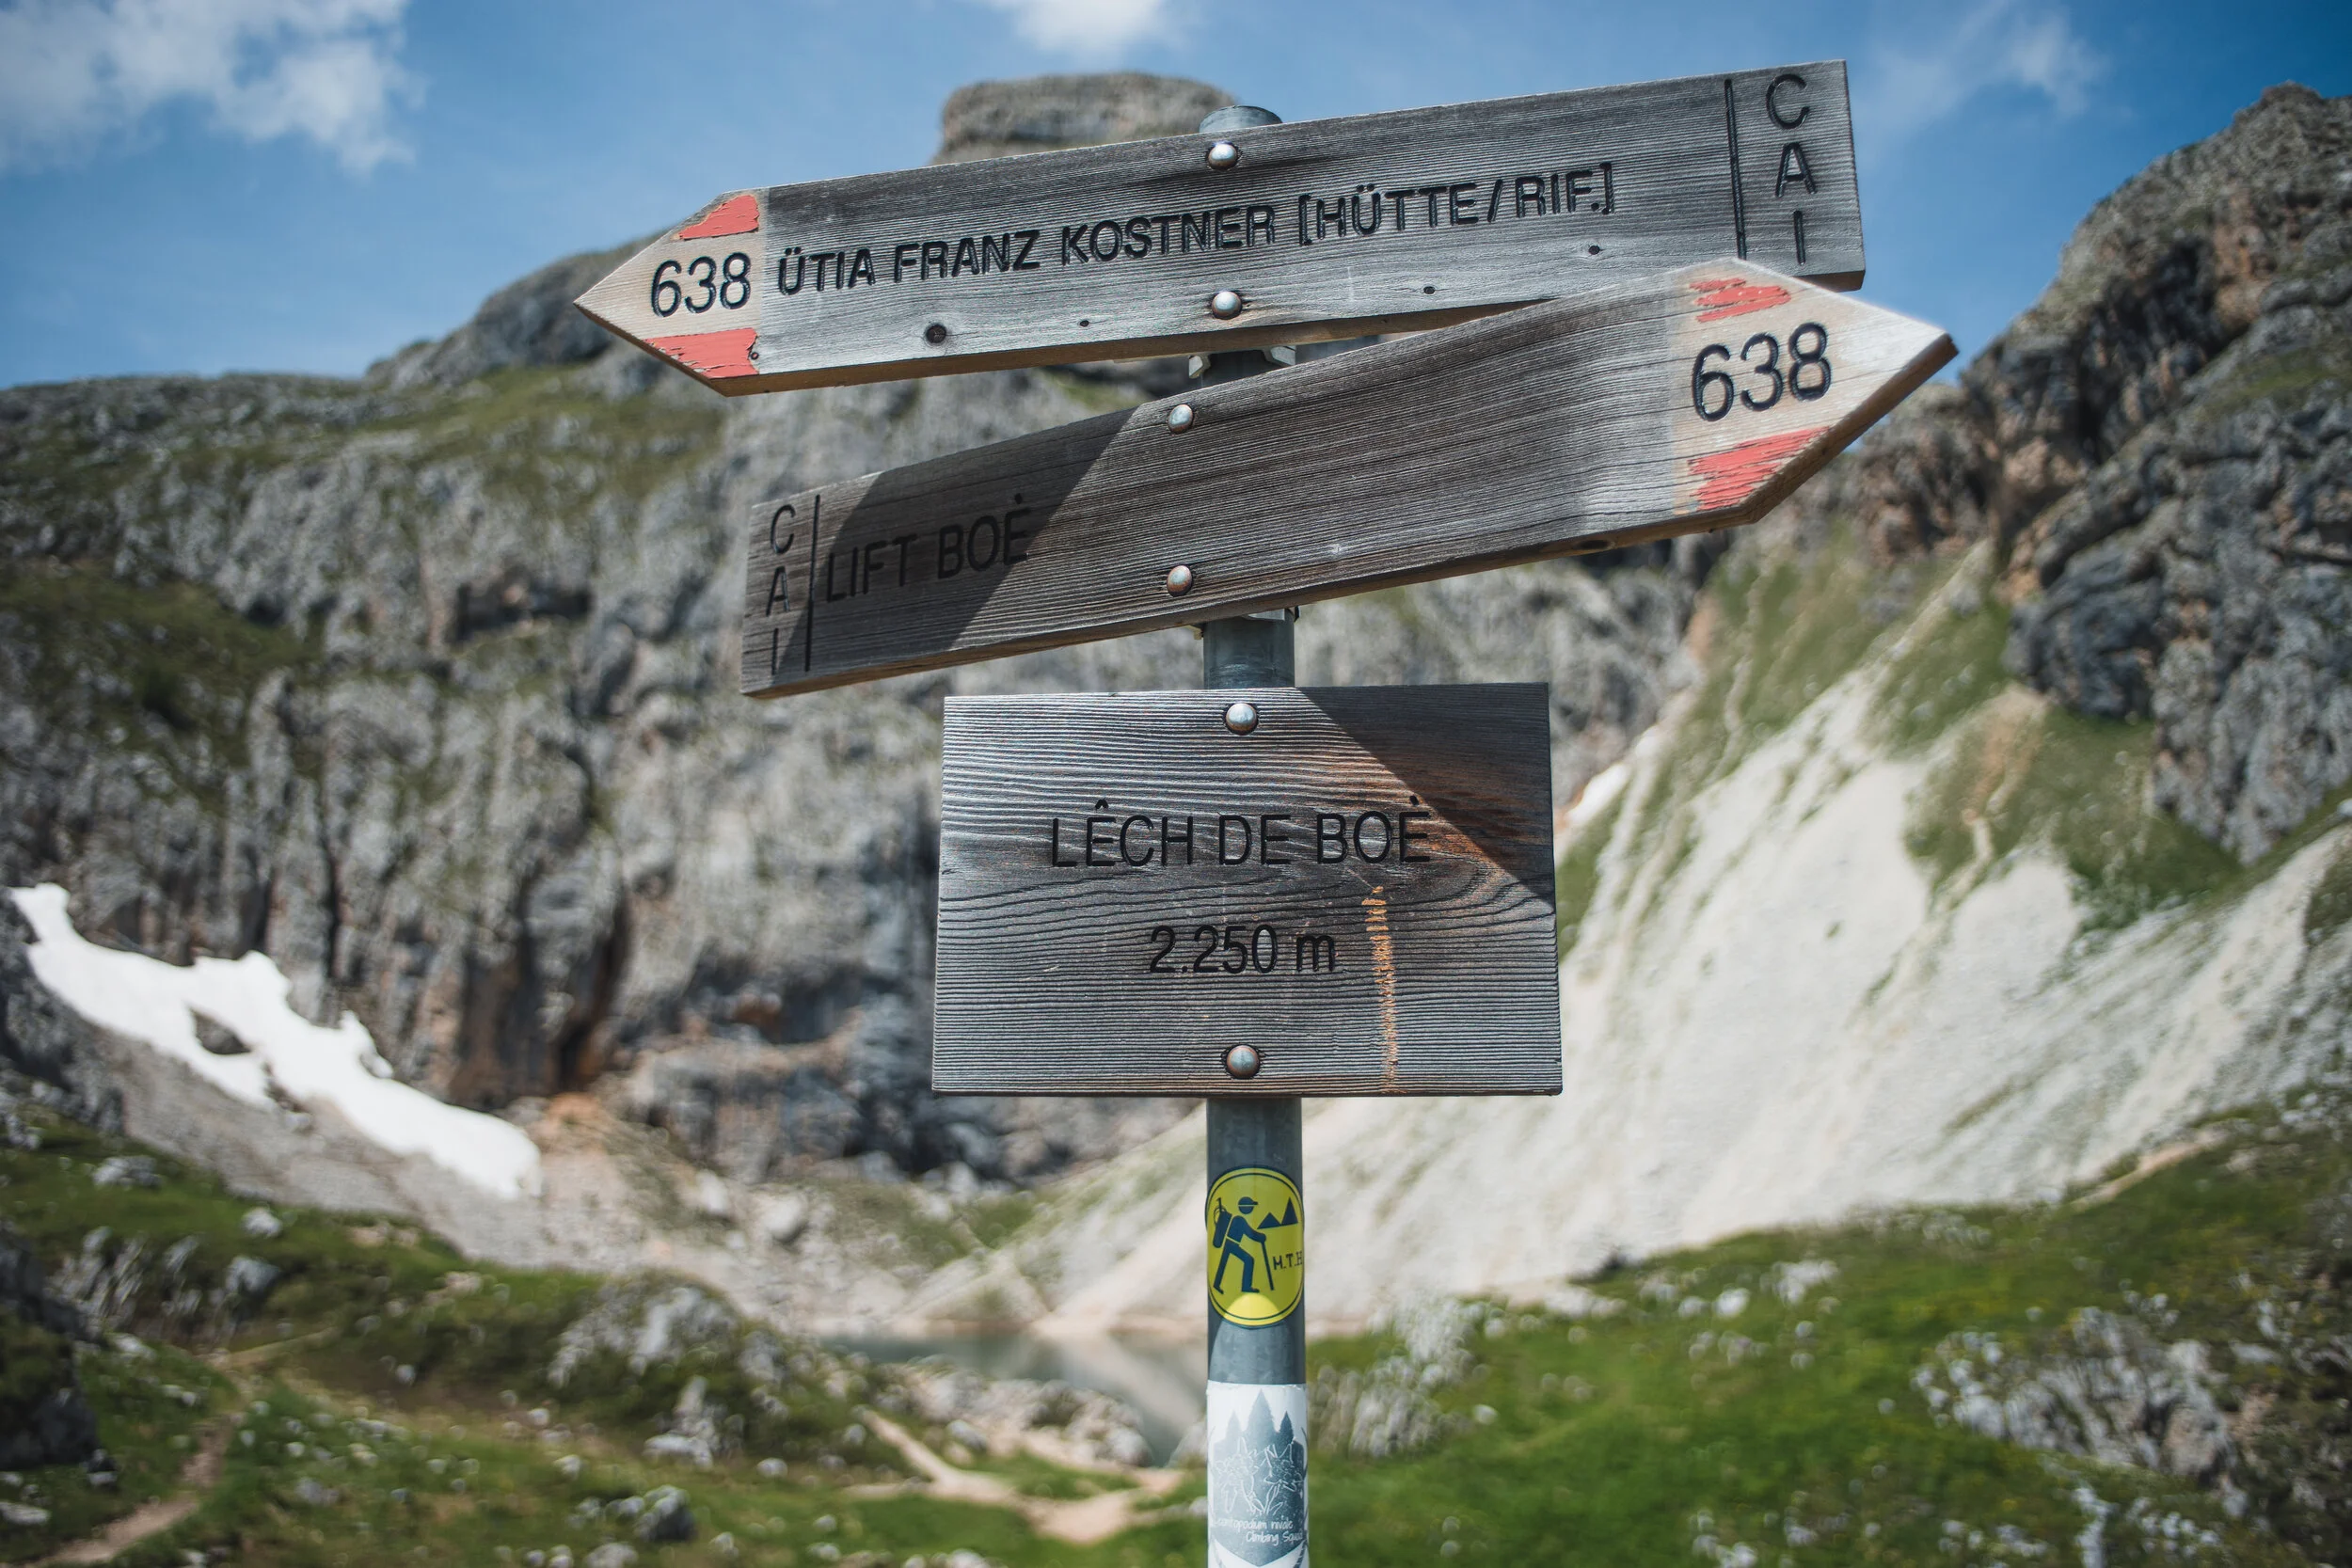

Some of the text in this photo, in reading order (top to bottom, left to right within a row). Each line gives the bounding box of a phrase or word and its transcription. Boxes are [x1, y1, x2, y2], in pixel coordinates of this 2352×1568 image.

[778, 162, 1614, 295] ÜTIA FRANZ KOSTNER [HÜTTE/RIF.]
[651, 251, 751, 317] 638
[1692, 322, 1831, 421] 638
[826, 533, 919, 603] LIFT
[1052, 798, 1194, 867] LÊCH
[1219, 814, 1292, 865] DE
[1150, 924, 1337, 974] 2.250 m
